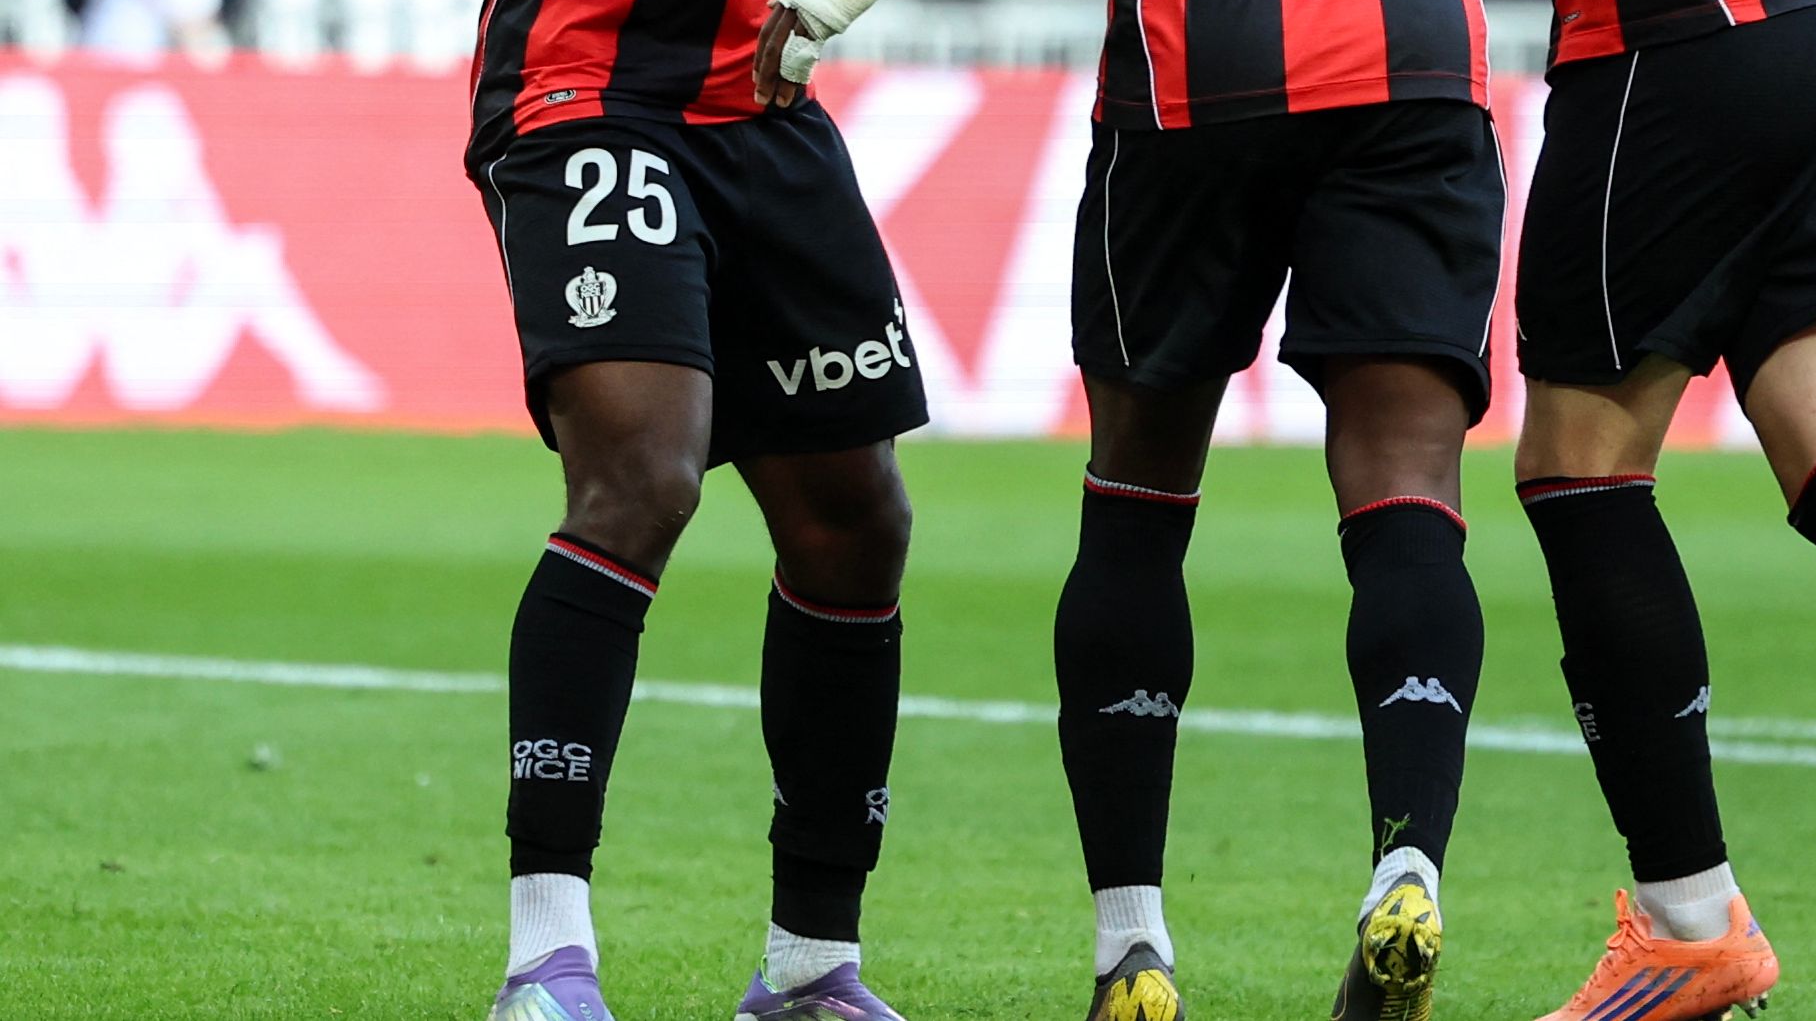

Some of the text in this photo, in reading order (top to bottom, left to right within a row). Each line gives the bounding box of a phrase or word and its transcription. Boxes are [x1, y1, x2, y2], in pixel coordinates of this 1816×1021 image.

[564, 147, 678, 247] 25
[766, 321, 912, 396] vbet
[513, 738, 592, 762] OGC
[513, 757, 592, 782] NICE
